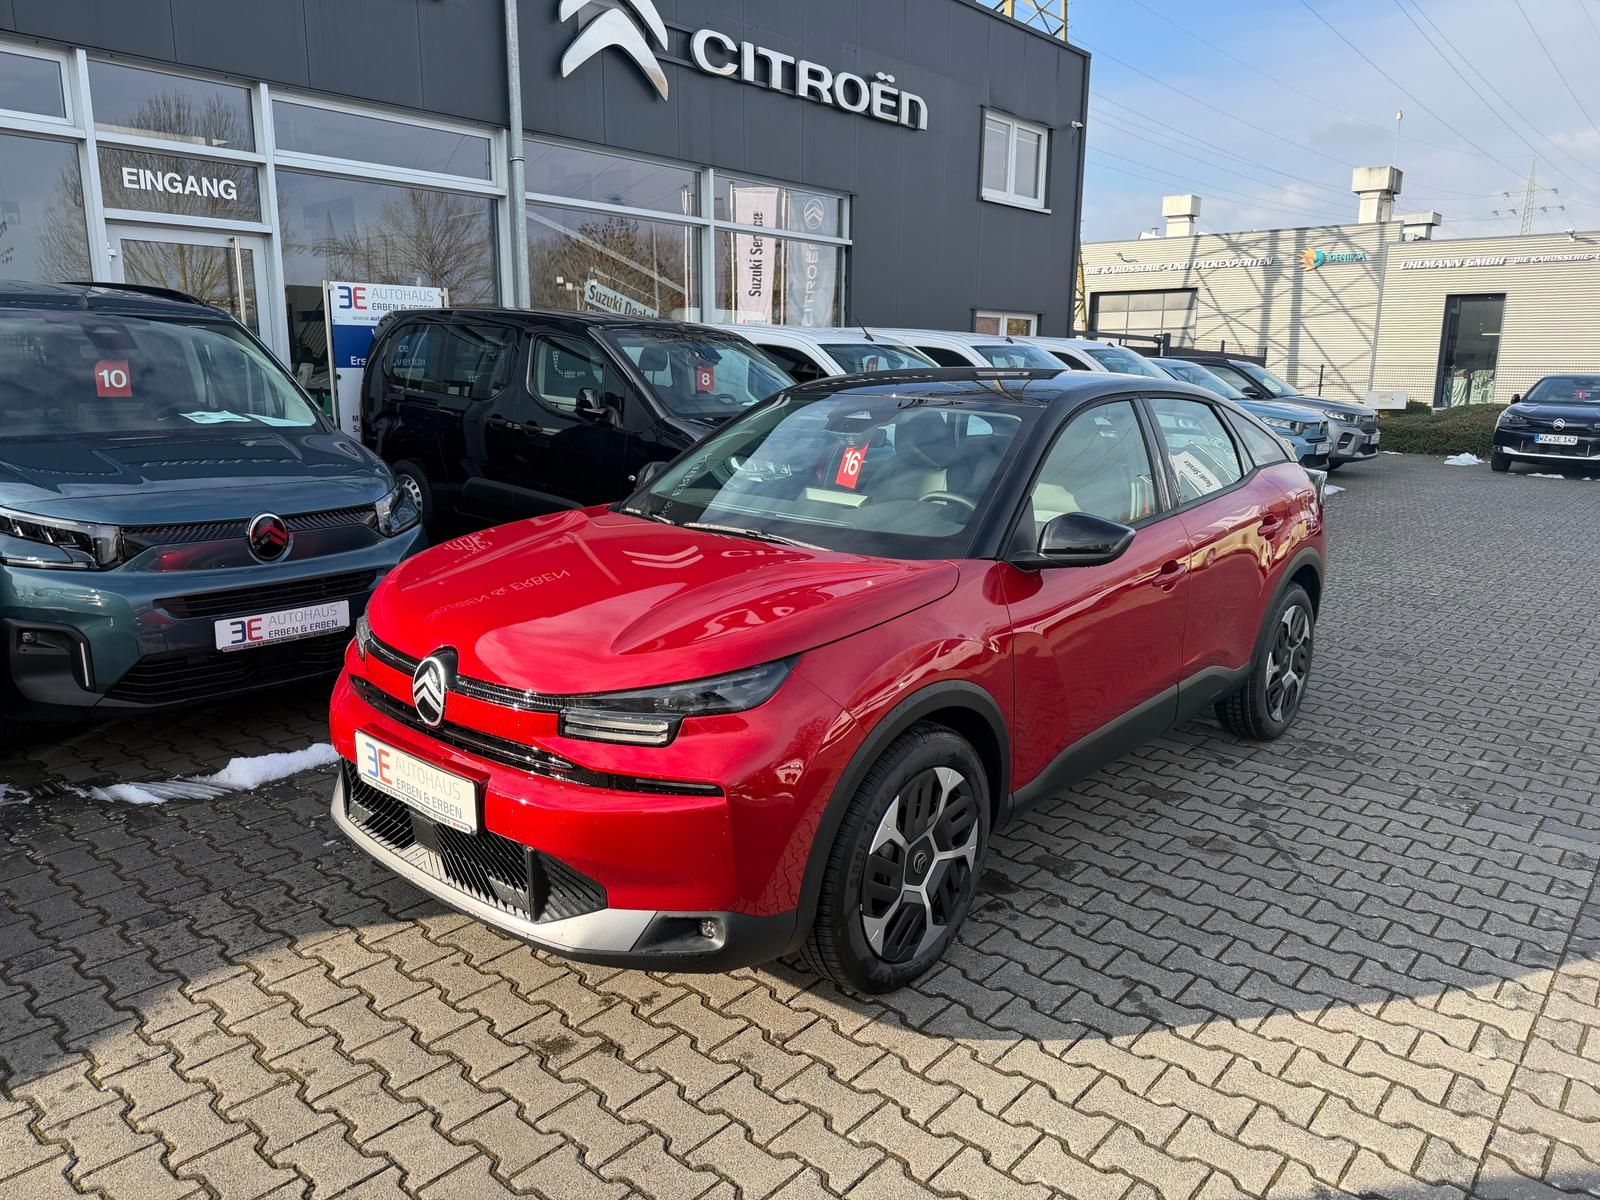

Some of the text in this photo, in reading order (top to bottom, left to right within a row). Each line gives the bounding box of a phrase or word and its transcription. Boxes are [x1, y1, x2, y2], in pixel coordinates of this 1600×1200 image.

[121, 167, 238, 200] EINGANG
[1400, 259, 1463, 270] UHLMANN
[748, 259, 763, 297] Suzuki
[371, 287, 434, 302] AUTOHAUS
[588, 285, 623, 313] Suzuki
[371, 302, 400, 312] ERBEN
[98, 369, 127, 388] 10
[702, 373, 711, 386] 8
[842, 451, 861, 476] 16
[268, 604, 338, 627] AUTOHAUS
[268, 626, 299, 639] ERBEN
[300, 624, 308, 633] &
[309, 619, 338, 631] ERBEN
[394, 756, 461, 800] AUTOHAUS
[396, 778, 421, 797] ERBEN
[423, 791, 430, 803] &
[432, 796, 463, 819] ERBEN
